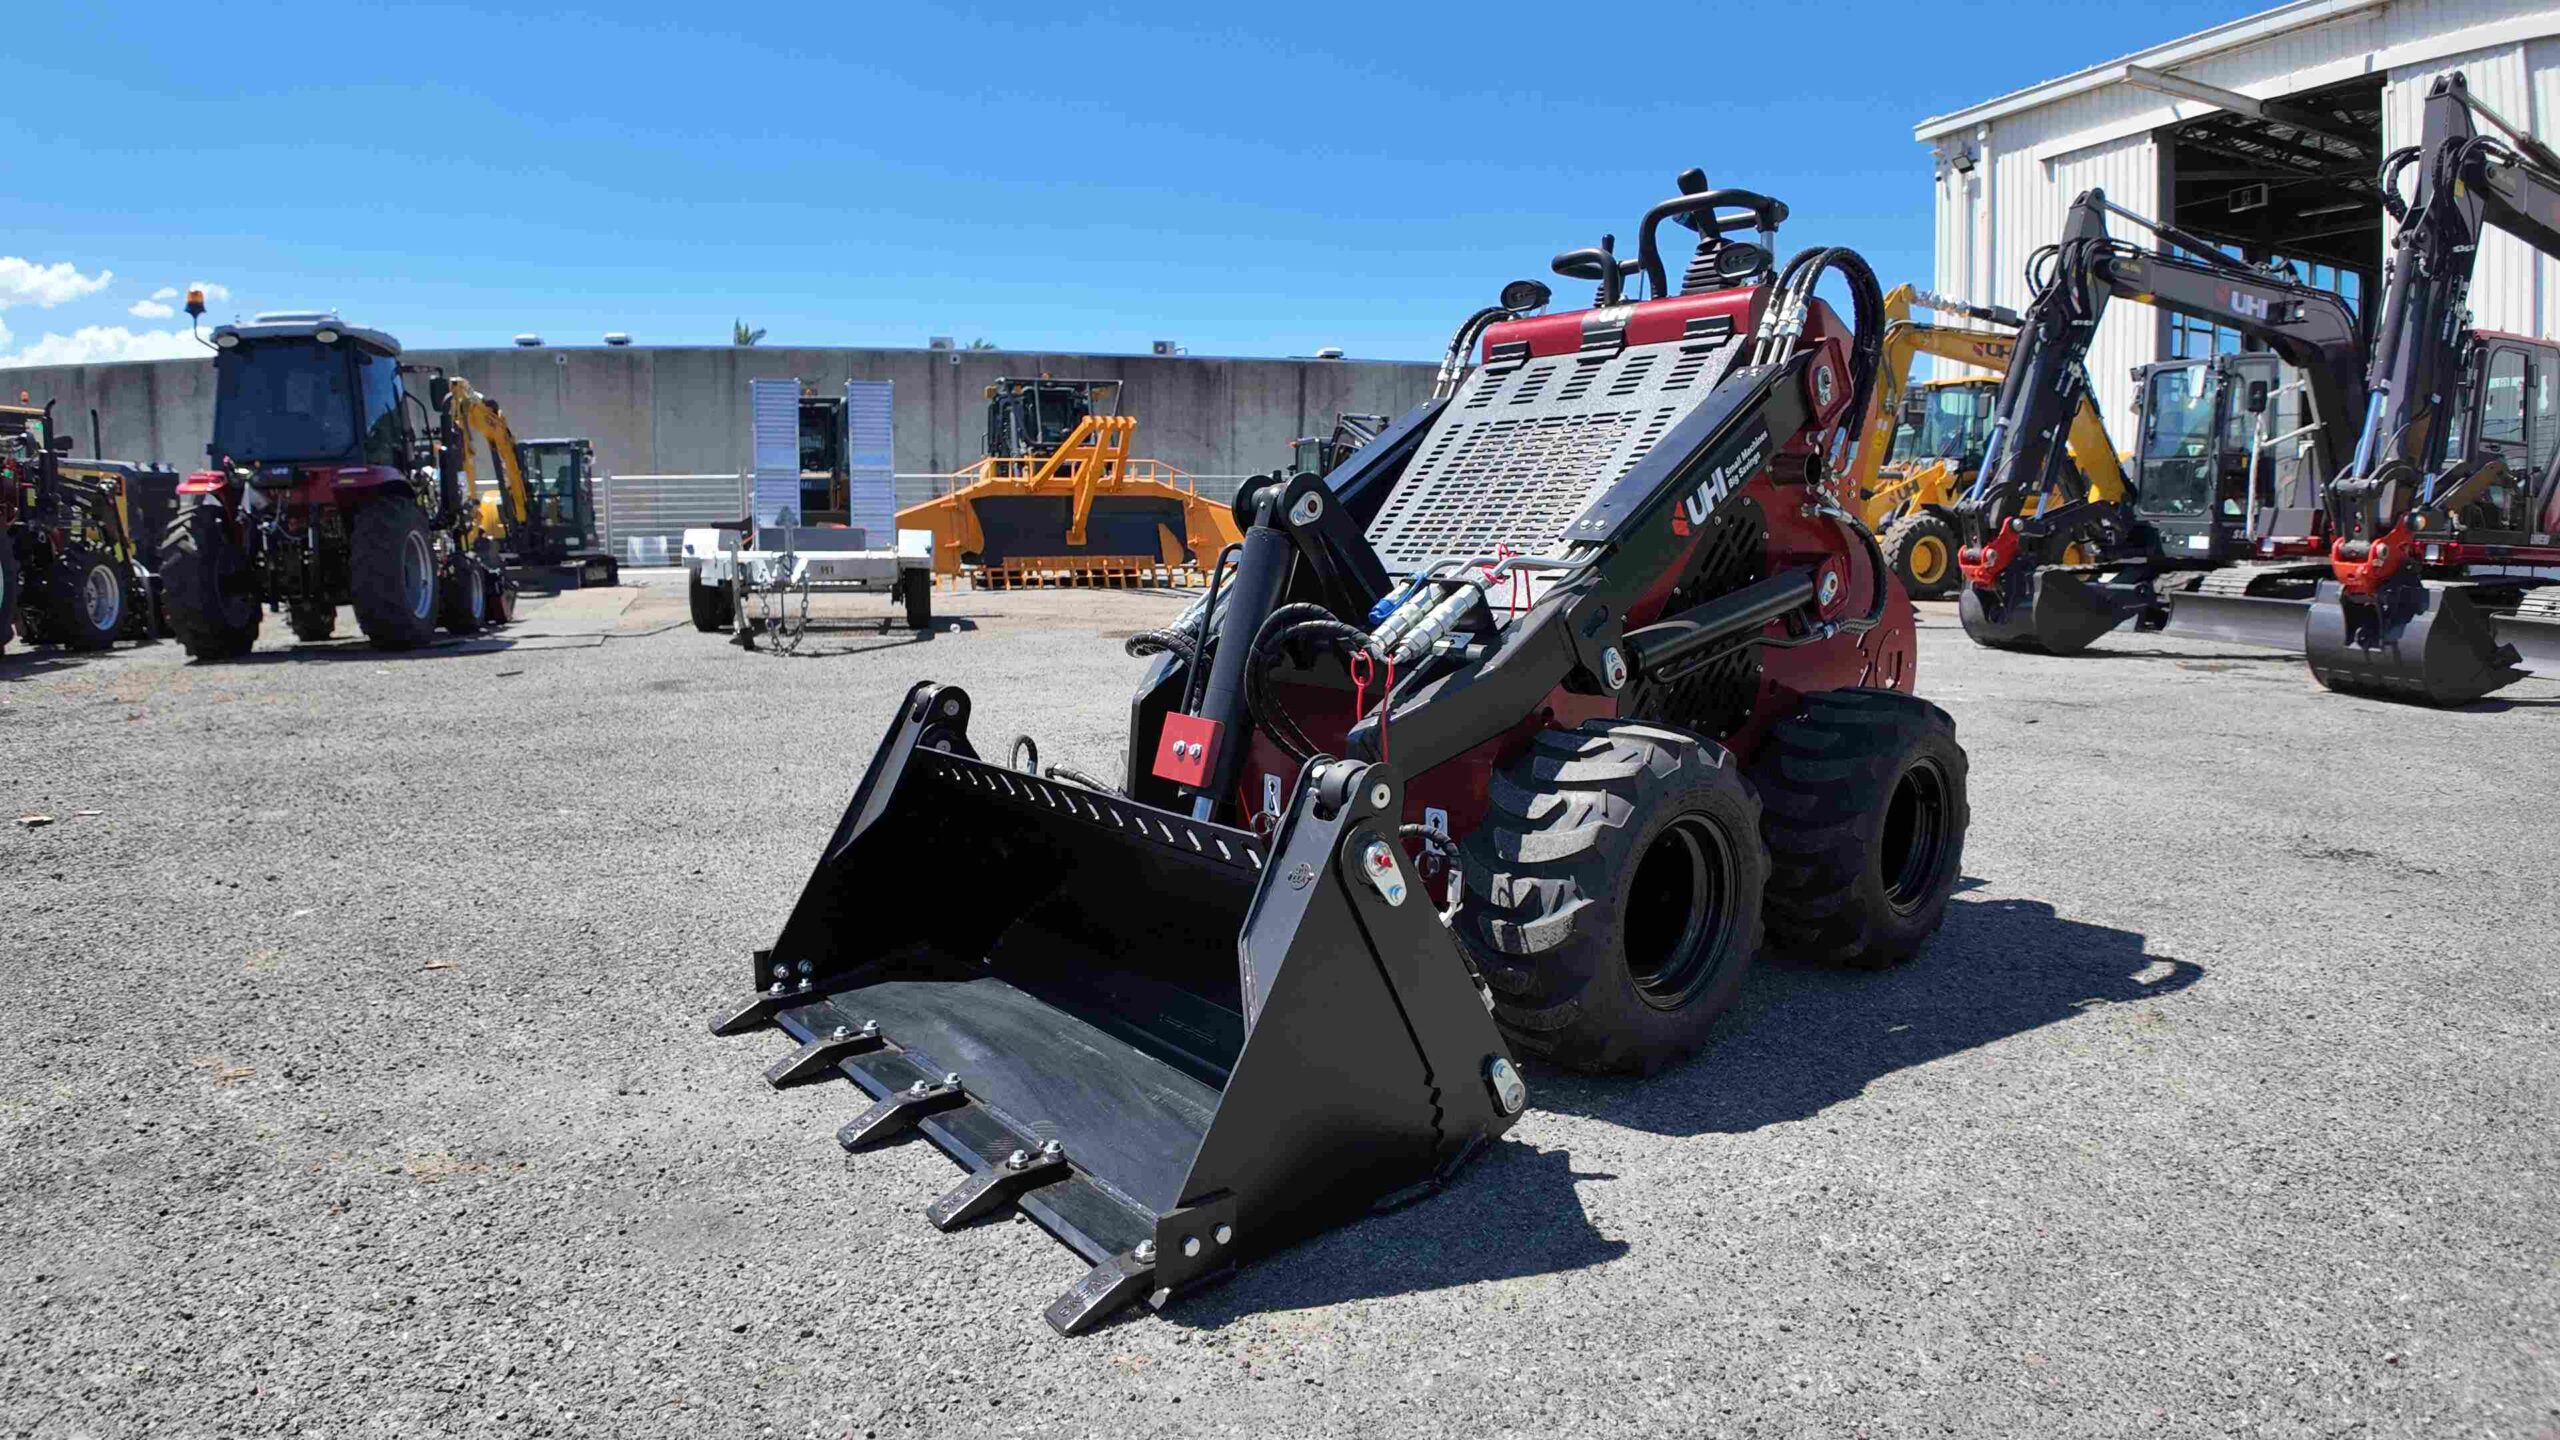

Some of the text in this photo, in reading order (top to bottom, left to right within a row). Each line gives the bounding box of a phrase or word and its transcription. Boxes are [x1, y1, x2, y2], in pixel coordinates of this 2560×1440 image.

[2231, 290, 2269, 320] UHI
[1725, 430, 1768, 478] Small Machines
[1727, 451, 1761, 489] Big Savings
[1685, 466, 1728, 526] UHI
